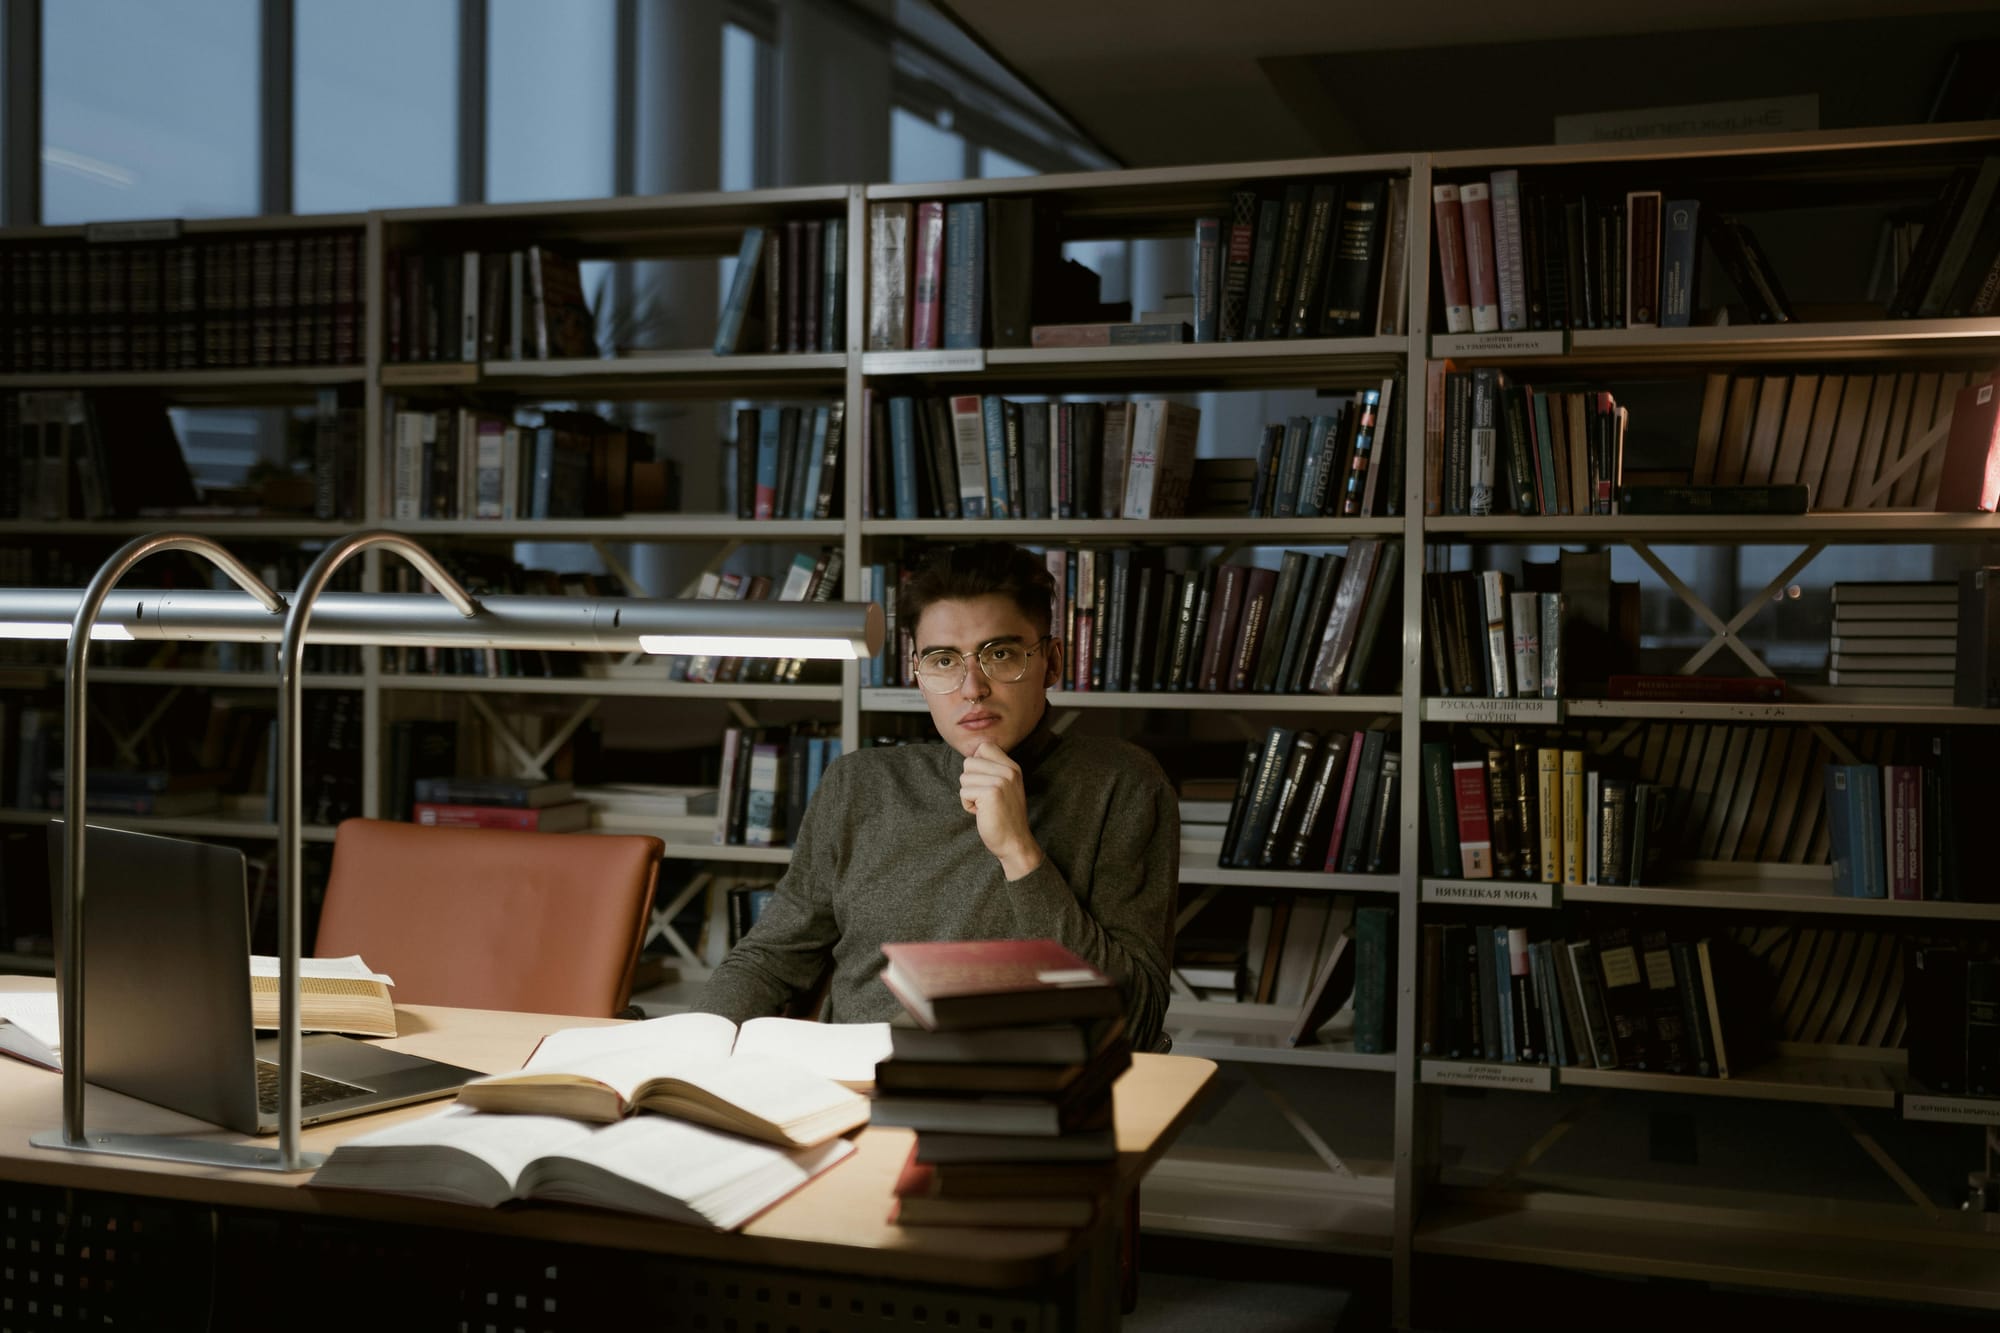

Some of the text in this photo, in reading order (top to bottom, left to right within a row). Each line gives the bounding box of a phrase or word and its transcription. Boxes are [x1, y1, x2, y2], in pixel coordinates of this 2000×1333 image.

[1181, 609, 1190, 621] OF
[1440, 700, 1543, 711] РУСКА-АНГЛІЙСКІЯ
[1466, 711, 1518, 722] СЛОЎНІКІ
[1435, 887, 1538, 900] НЯМЕЦКАЯ МОВА
